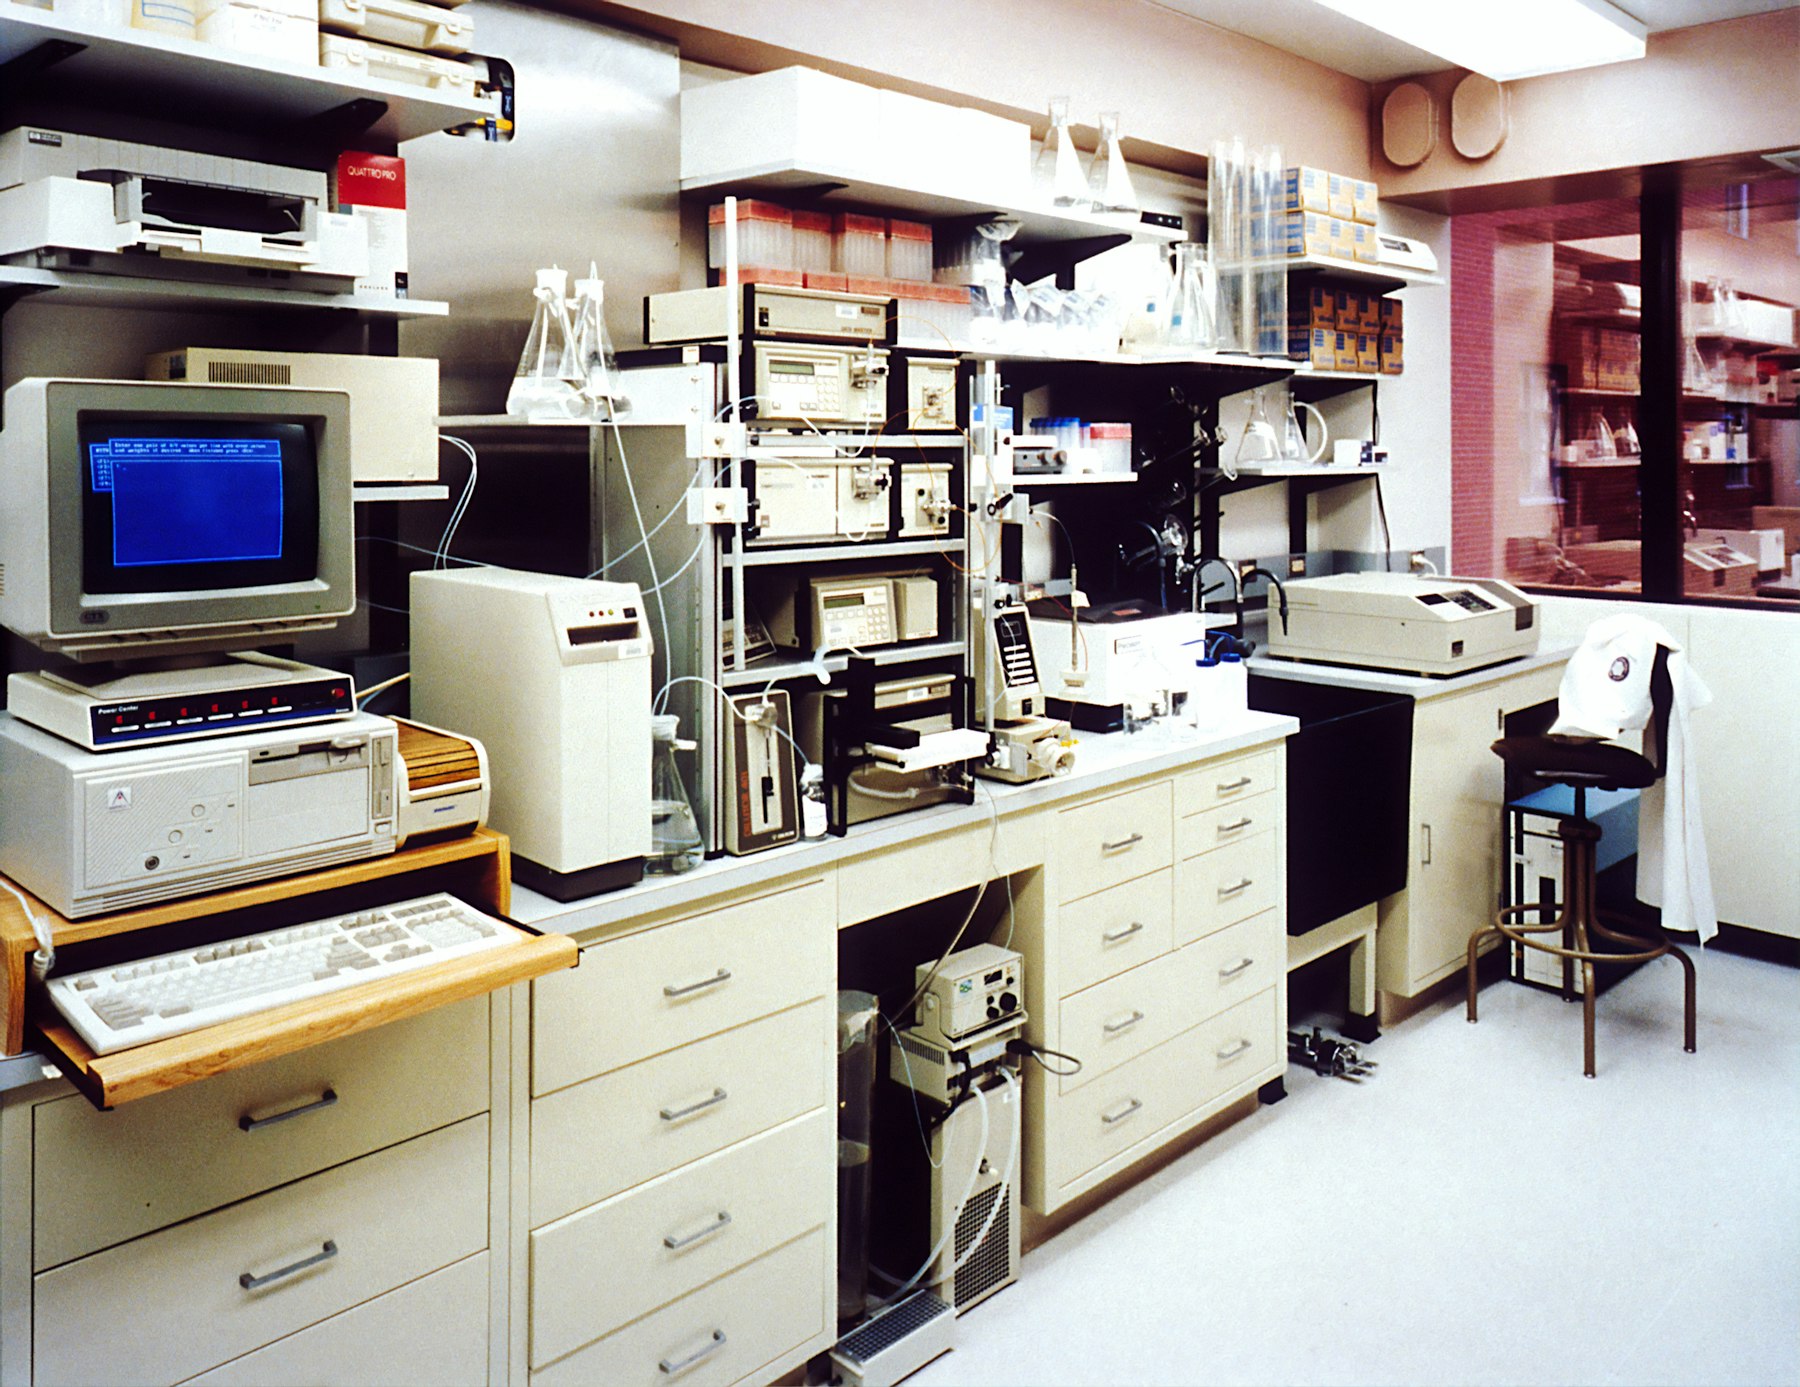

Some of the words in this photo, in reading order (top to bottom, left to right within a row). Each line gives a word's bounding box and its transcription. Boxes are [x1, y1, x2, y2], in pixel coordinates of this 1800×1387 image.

[347, 165, 381, 179] QUATTRO
[381, 170, 397, 181] PRO
[98, 707, 118, 715] Power
